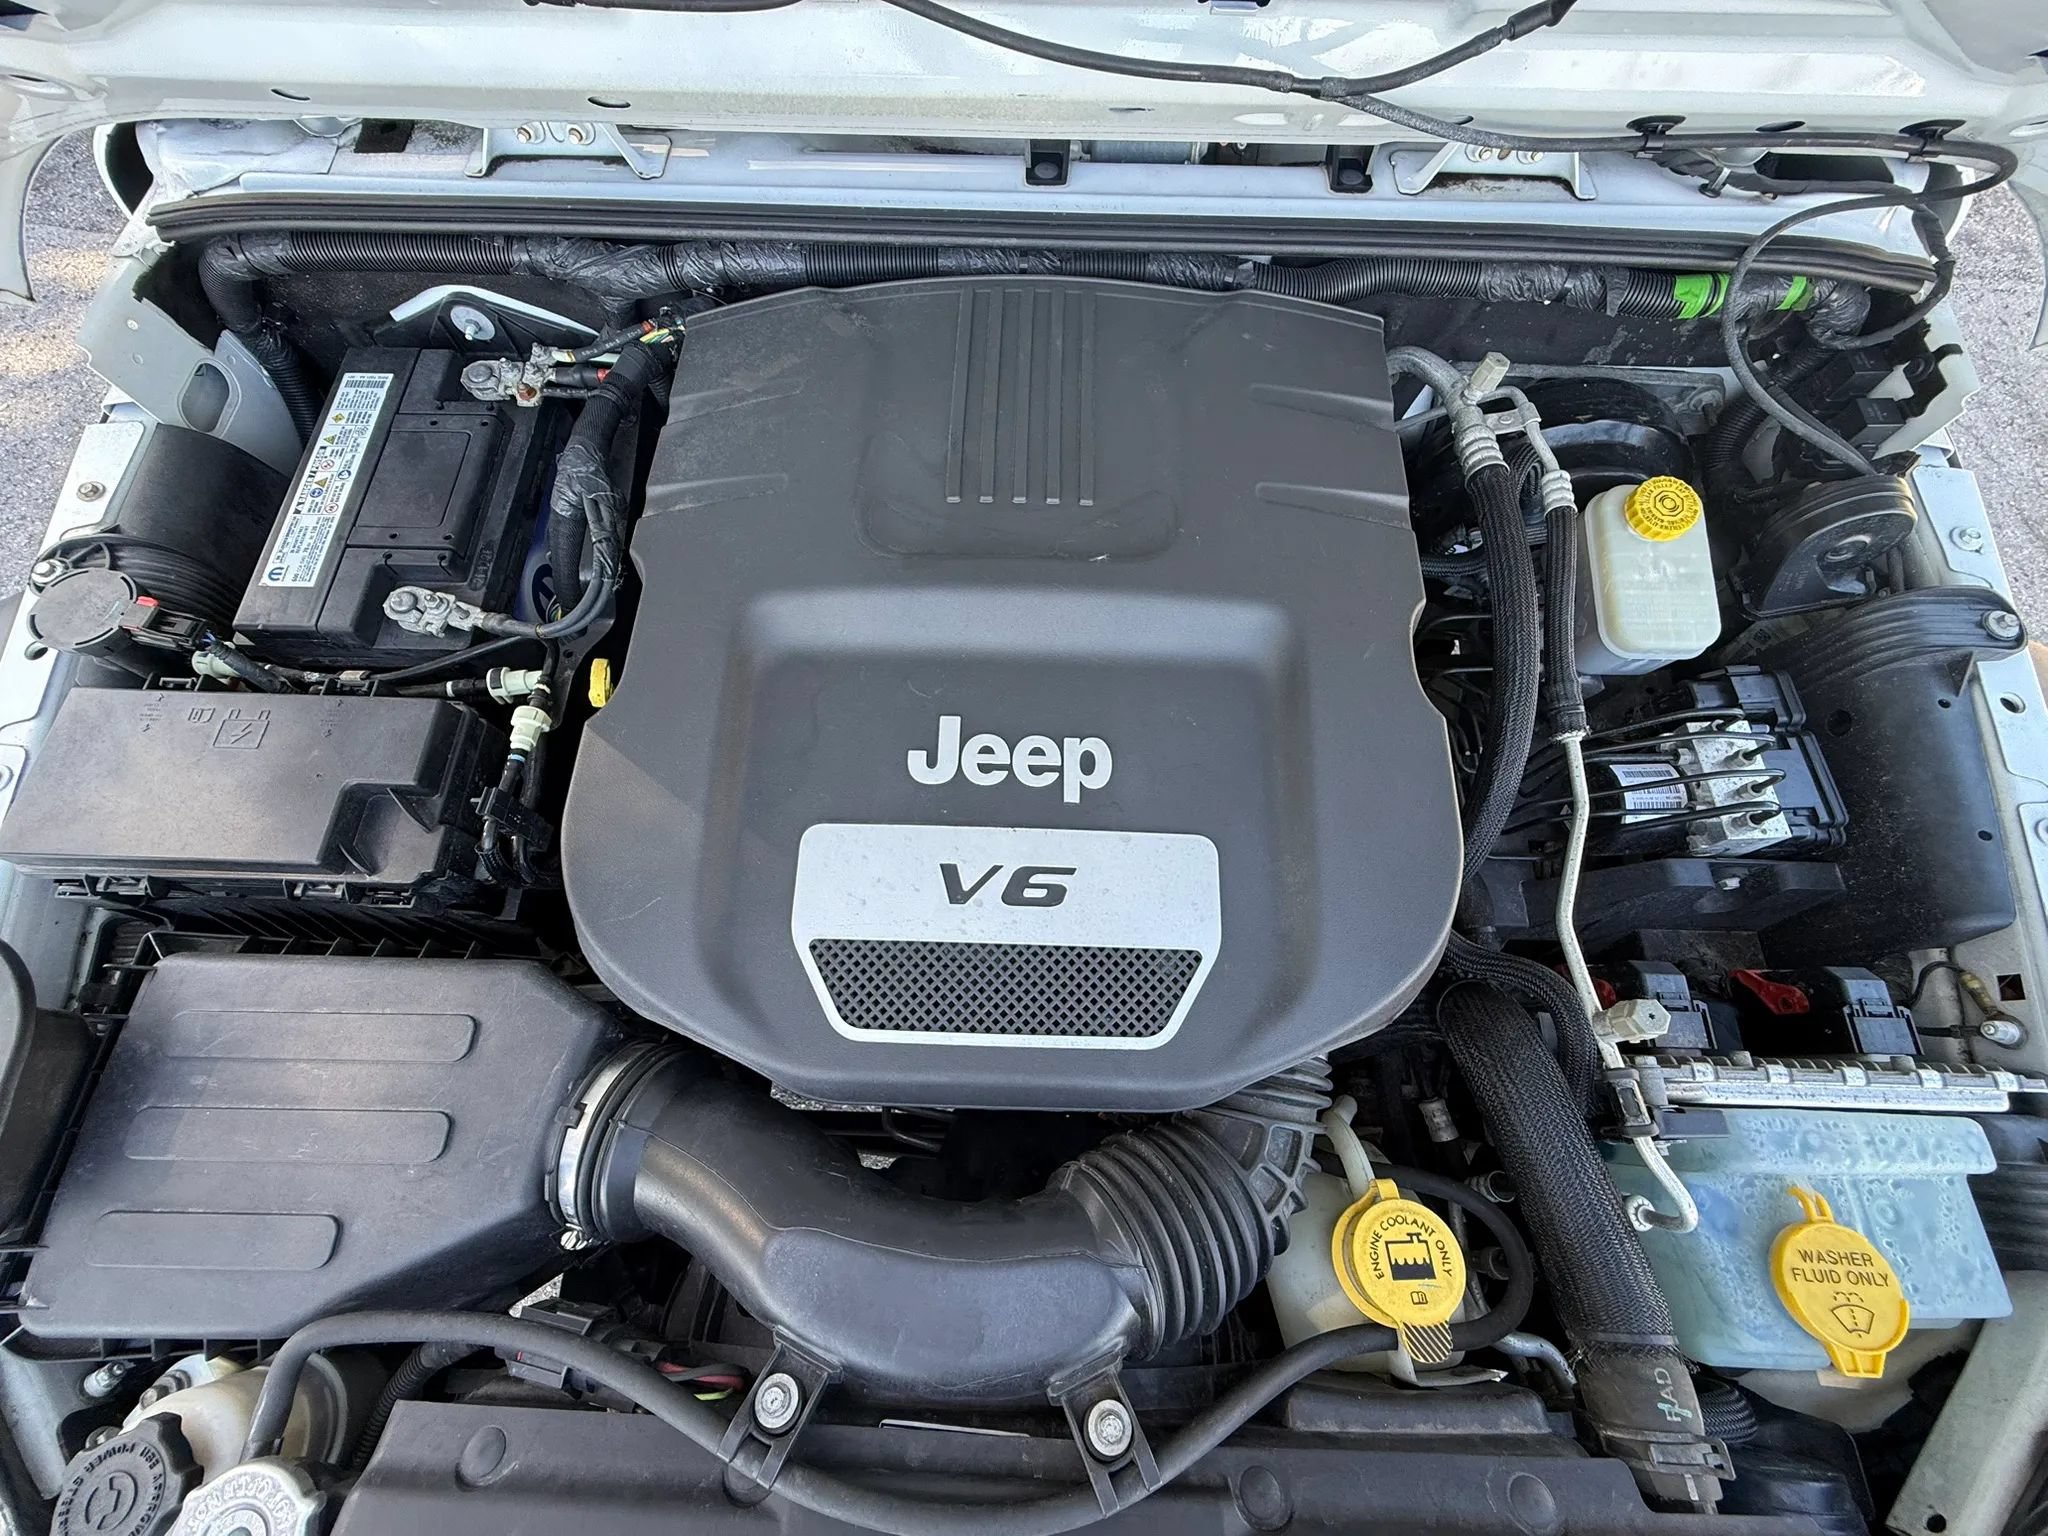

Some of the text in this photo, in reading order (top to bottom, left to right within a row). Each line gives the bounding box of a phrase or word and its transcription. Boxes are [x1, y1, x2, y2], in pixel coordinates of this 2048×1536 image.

[907, 715, 1113, 804] Jeep
[939, 862, 1078, 908] V6
[1369, 1214, 1452, 1280] ENGINE COOLANT ONLY
[1798, 1249, 1874, 1268] WASHER
[1792, 1267, 1889, 1288] FLUID ONLY
[84, 1442, 136, 1474] POWER
[139, 1446, 162, 1470] USE
